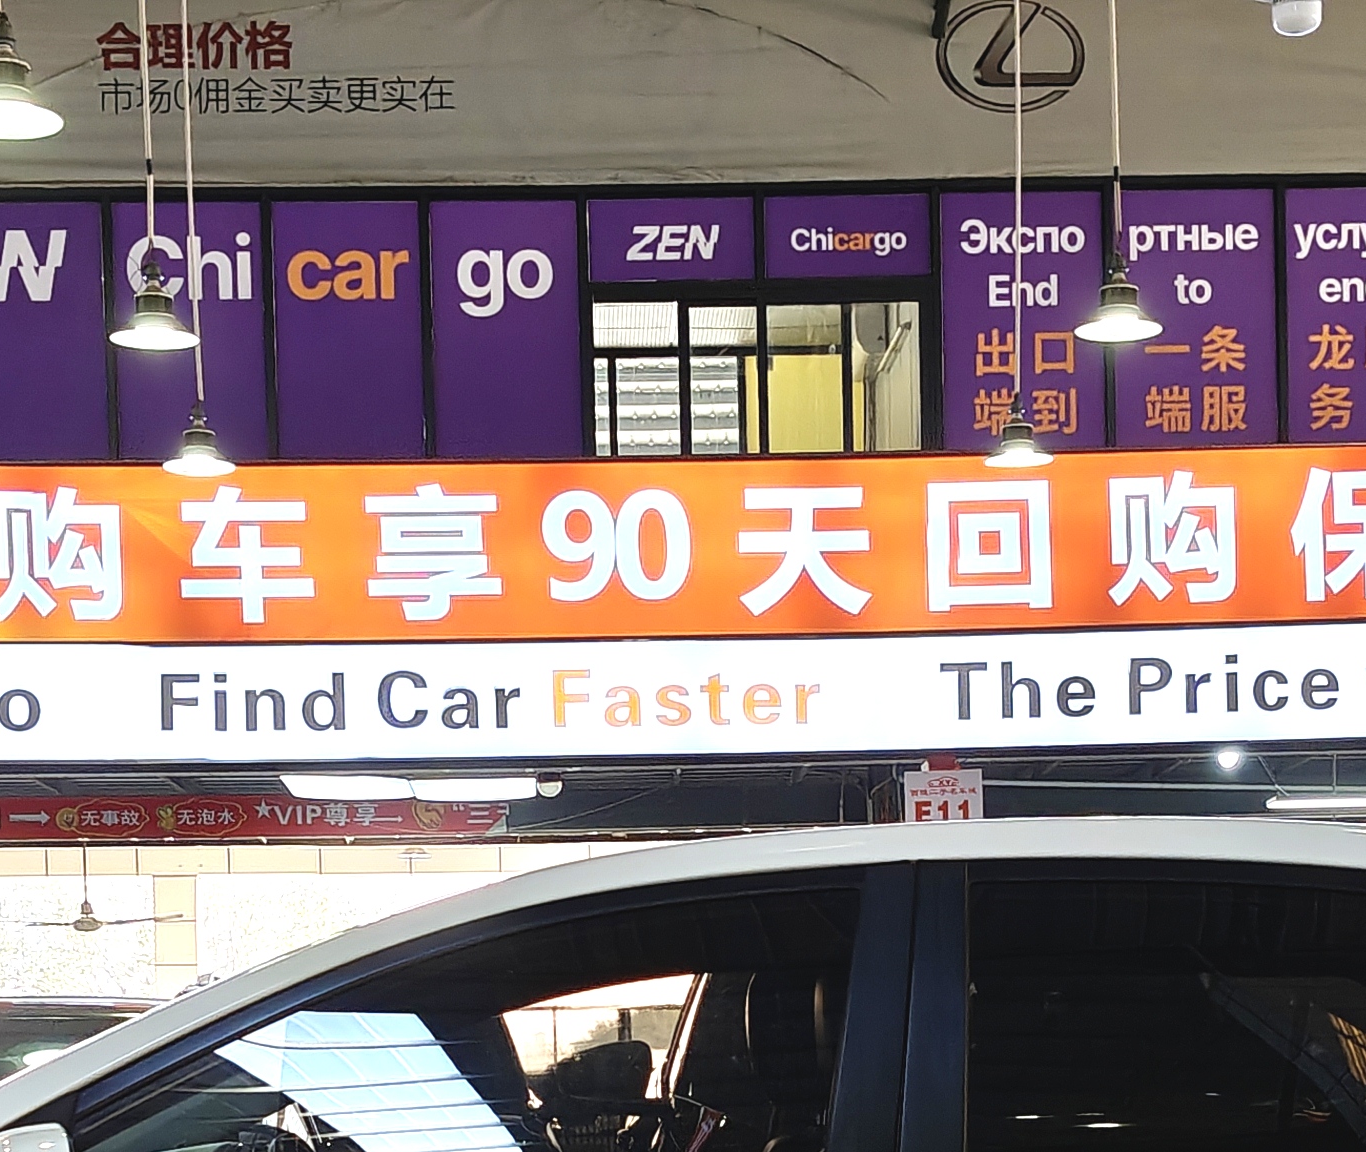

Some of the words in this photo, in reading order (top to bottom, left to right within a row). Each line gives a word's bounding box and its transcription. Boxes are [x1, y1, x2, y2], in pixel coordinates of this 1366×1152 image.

[96, 21, 293, 71] 合理价格
[626, 224, 720, 262] ZEN
[790, 227, 908, 257] Chicargo
[959, 218, 1086, 255] Экспо
[1128, 220, 1260, 261] ртные
[987, 273, 1059, 308] End
[1173, 274, 1213, 305] to
[974, 328, 1076, 376] 出口
[1144, 325, 1247, 373] 一条
[1144, 385, 1248, 433] 端服
[159, 670, 346, 732] Find
[378, 670, 521, 731] Car
[552, 668, 821, 728] Faster
[939, 660, 1097, 721] The
[1128, 653, 1341, 717] Price
[80, 809, 141, 827] 无事故
[176, 809, 236, 826] 无泡水
[915, 799, 970, 822] E11
